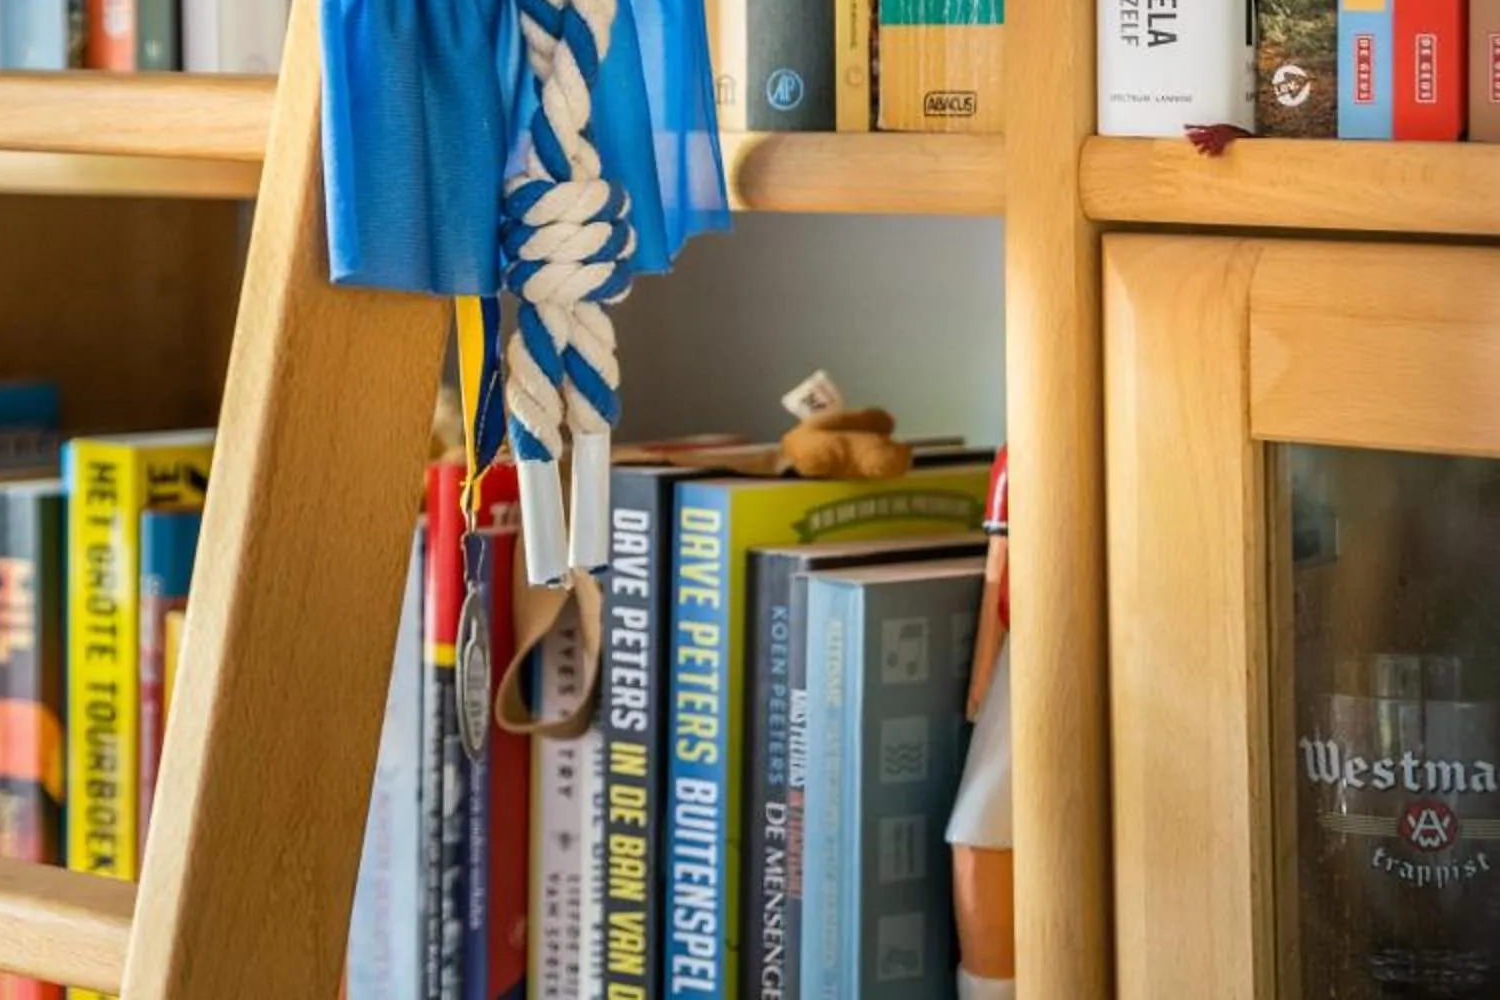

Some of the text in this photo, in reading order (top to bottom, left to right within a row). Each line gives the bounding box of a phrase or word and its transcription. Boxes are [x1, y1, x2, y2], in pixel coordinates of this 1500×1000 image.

[1358, 38, 1369, 58] DE
[1419, 37, 1433, 99] DE GEUS
[926, 96, 974, 113] ABACUS
[85, 459, 118, 530] HET
[612, 507, 649, 598] DAVE
[557, 628, 576, 696] YVES
[610, 605, 649, 732] PETERS
[770, 604, 788, 674] KOEN
[609, 741, 647, 776] IN
[671, 506, 720, 994] DAVE PETERS BUITENSPEL
[767, 683, 787, 785] PEETERS
[1300, 734, 1498, 793] Westma
[85, 679, 118, 874] TOURBOEK
[609, 783, 647, 828] DE
[764, 800, 786, 840] DE
[608, 834, 647, 902] BAN
[1371, 847, 1491, 889] trappist
[608, 911, 646, 976] VAN
